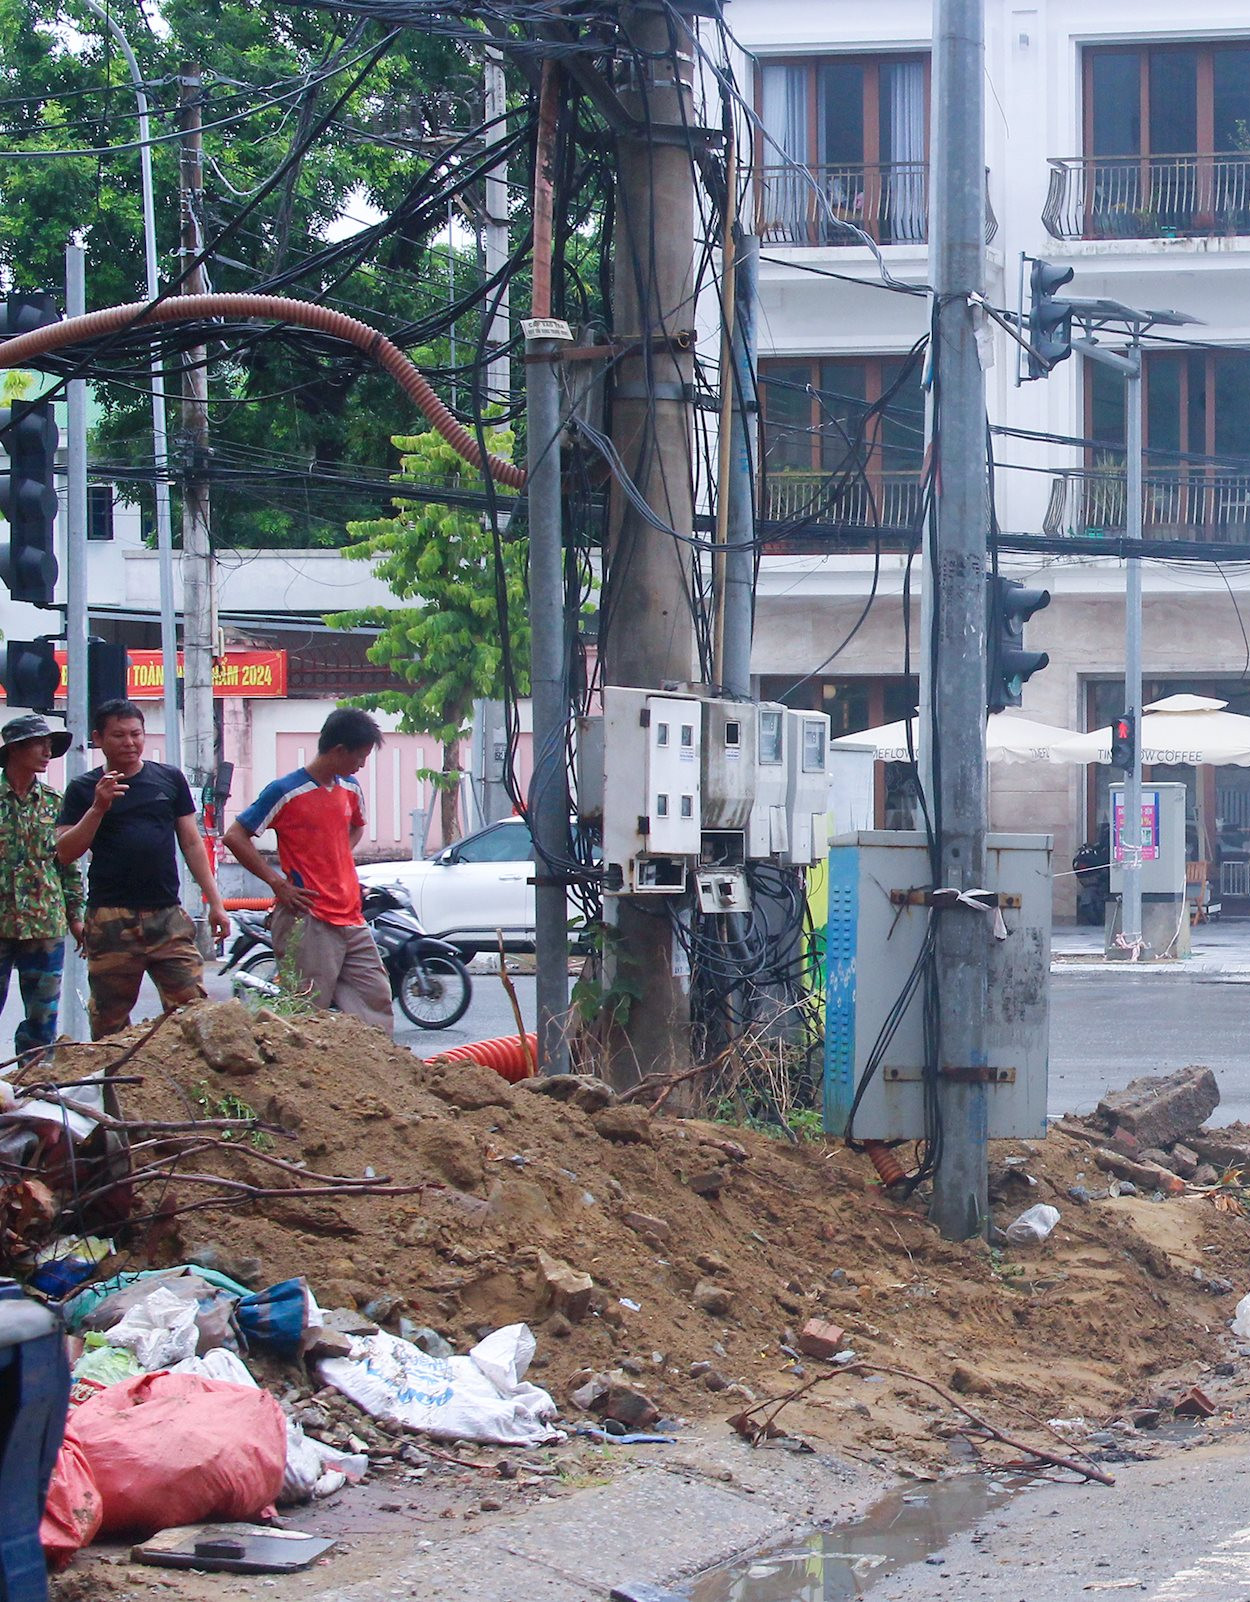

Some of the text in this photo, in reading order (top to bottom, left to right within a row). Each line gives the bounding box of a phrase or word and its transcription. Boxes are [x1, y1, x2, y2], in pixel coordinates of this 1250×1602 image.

[133, 660, 163, 687] TOÀN
[242, 665, 272, 686] 2024
[1157, 749, 1203, 762] COFFEE
